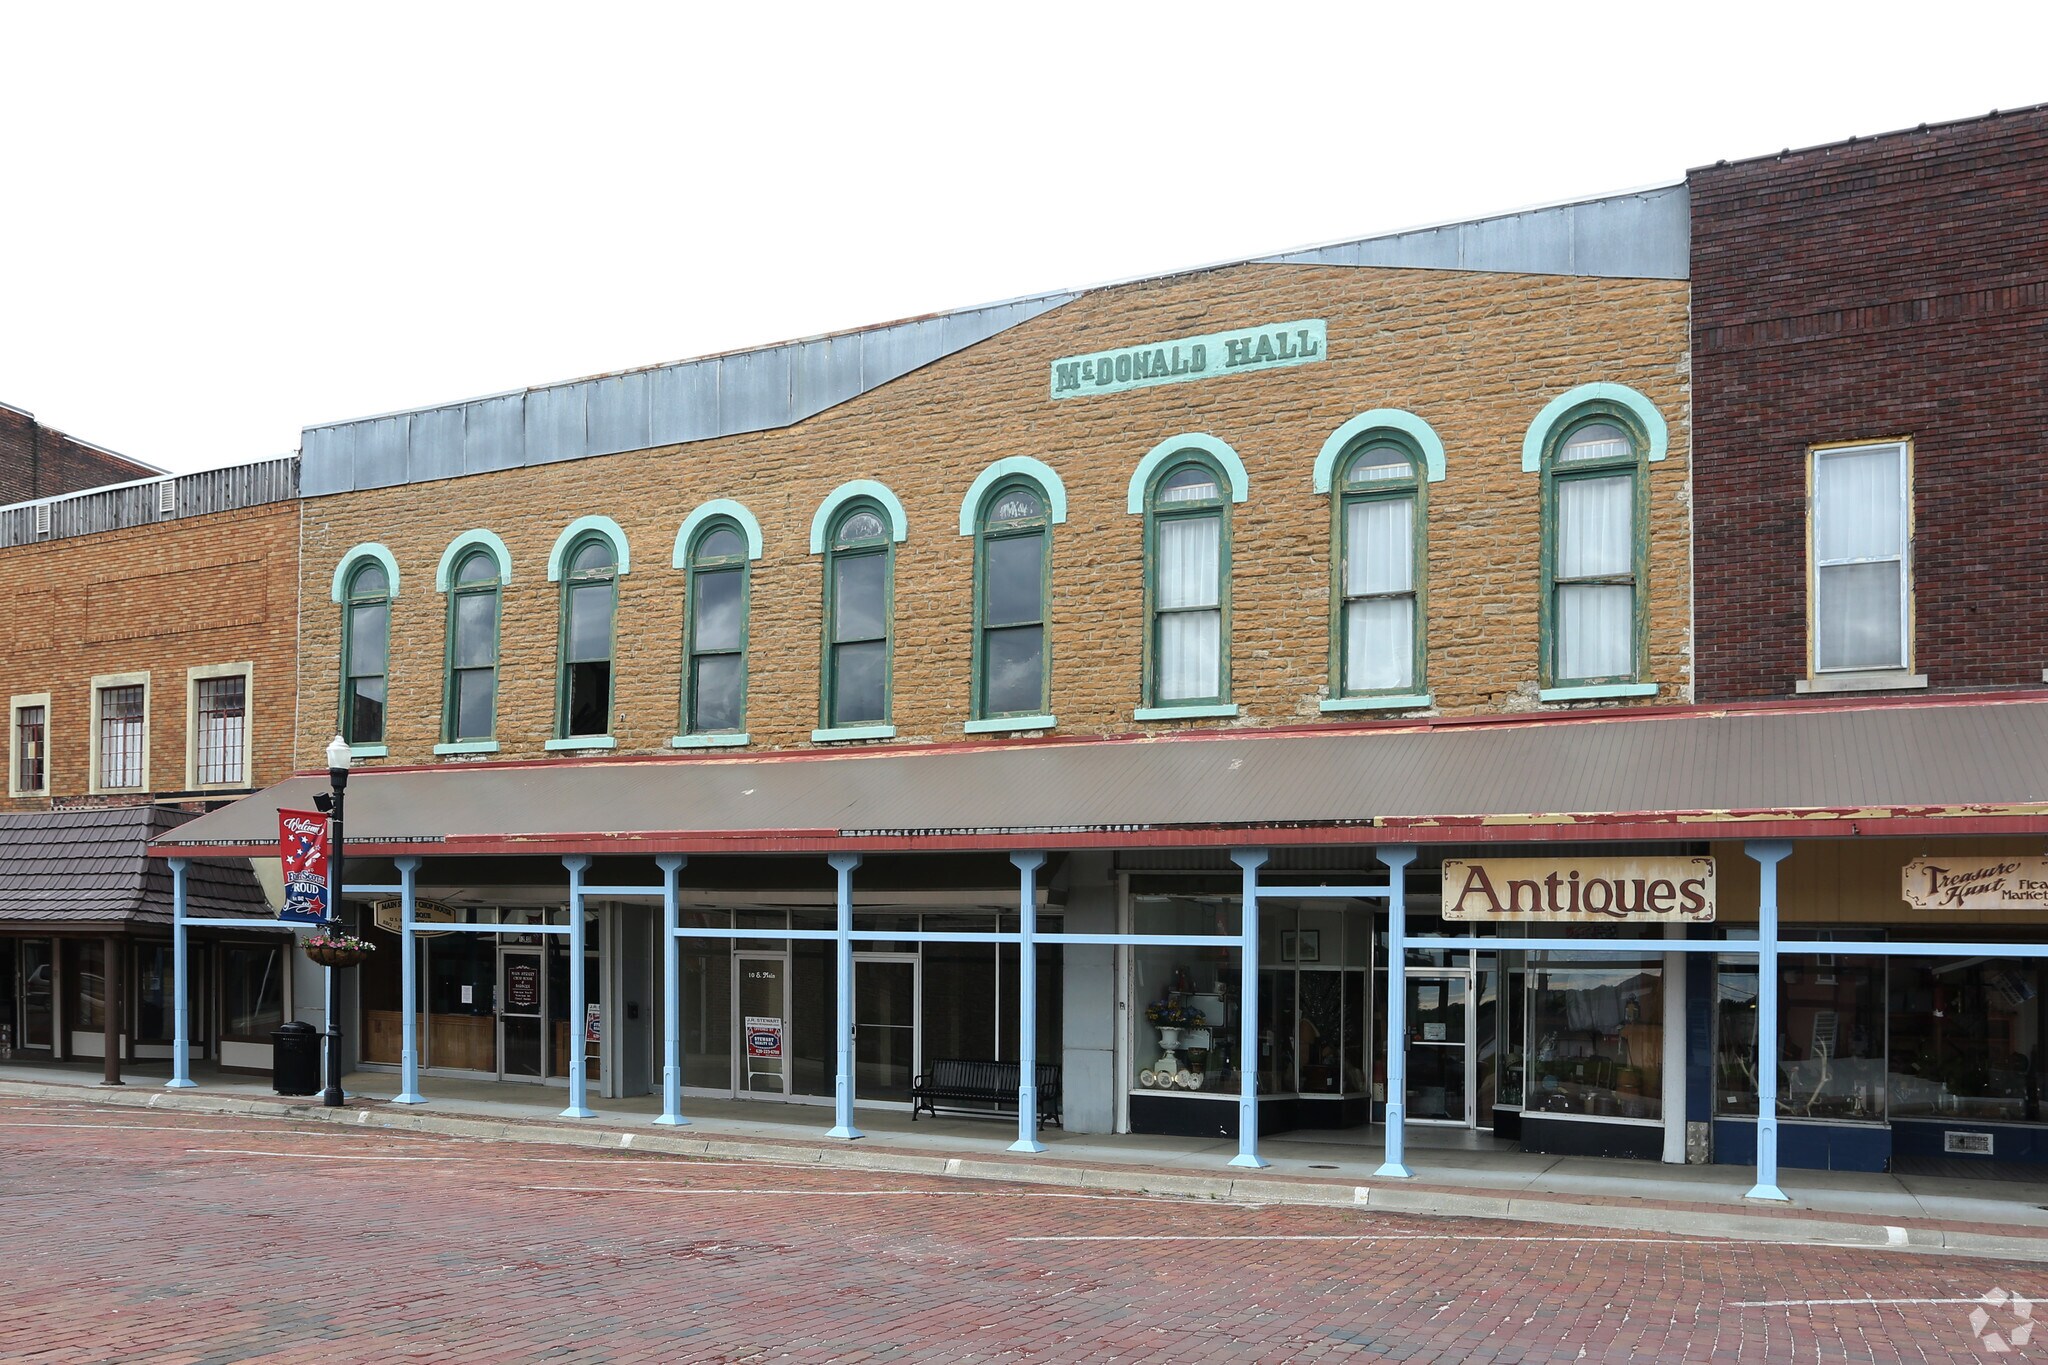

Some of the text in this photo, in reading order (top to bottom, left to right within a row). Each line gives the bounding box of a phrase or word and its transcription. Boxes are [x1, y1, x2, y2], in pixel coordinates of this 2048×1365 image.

[1224, 329, 1320, 368] HALL
[291, 882, 319, 894] ROUD
[1921, 862, 2021, 896] Treasure
[2019, 879, 2048, 890] Flea
[1450, 865, 1707, 918] Antiques
[1938, 878, 2007, 908] Hunt
[2002, 889, 2048, 900] Market
[762, 971, 776, 979] Main
